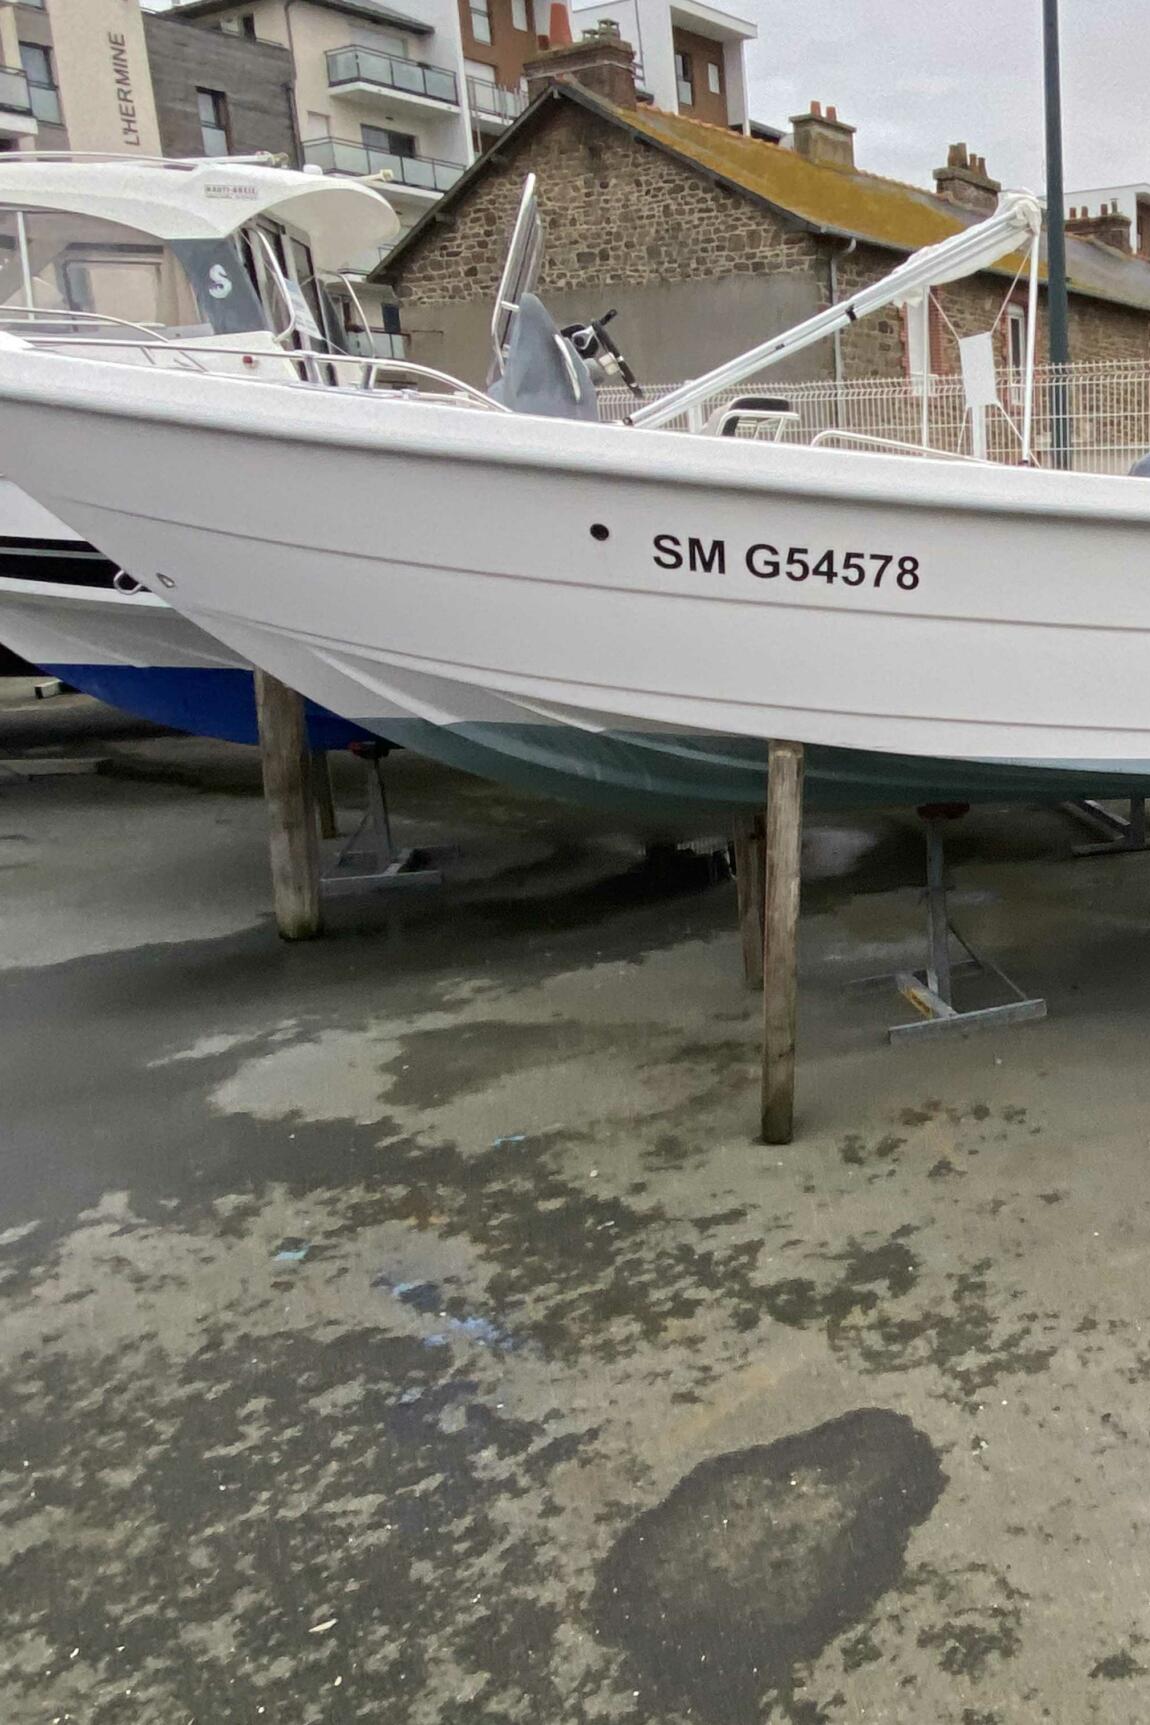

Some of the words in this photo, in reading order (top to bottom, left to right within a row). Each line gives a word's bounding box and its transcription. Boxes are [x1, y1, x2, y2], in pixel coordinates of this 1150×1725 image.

[108, 31, 141, 147] L'HERMINE
[652, 534, 726, 574] SM
[745, 544, 920, 590] G54578
